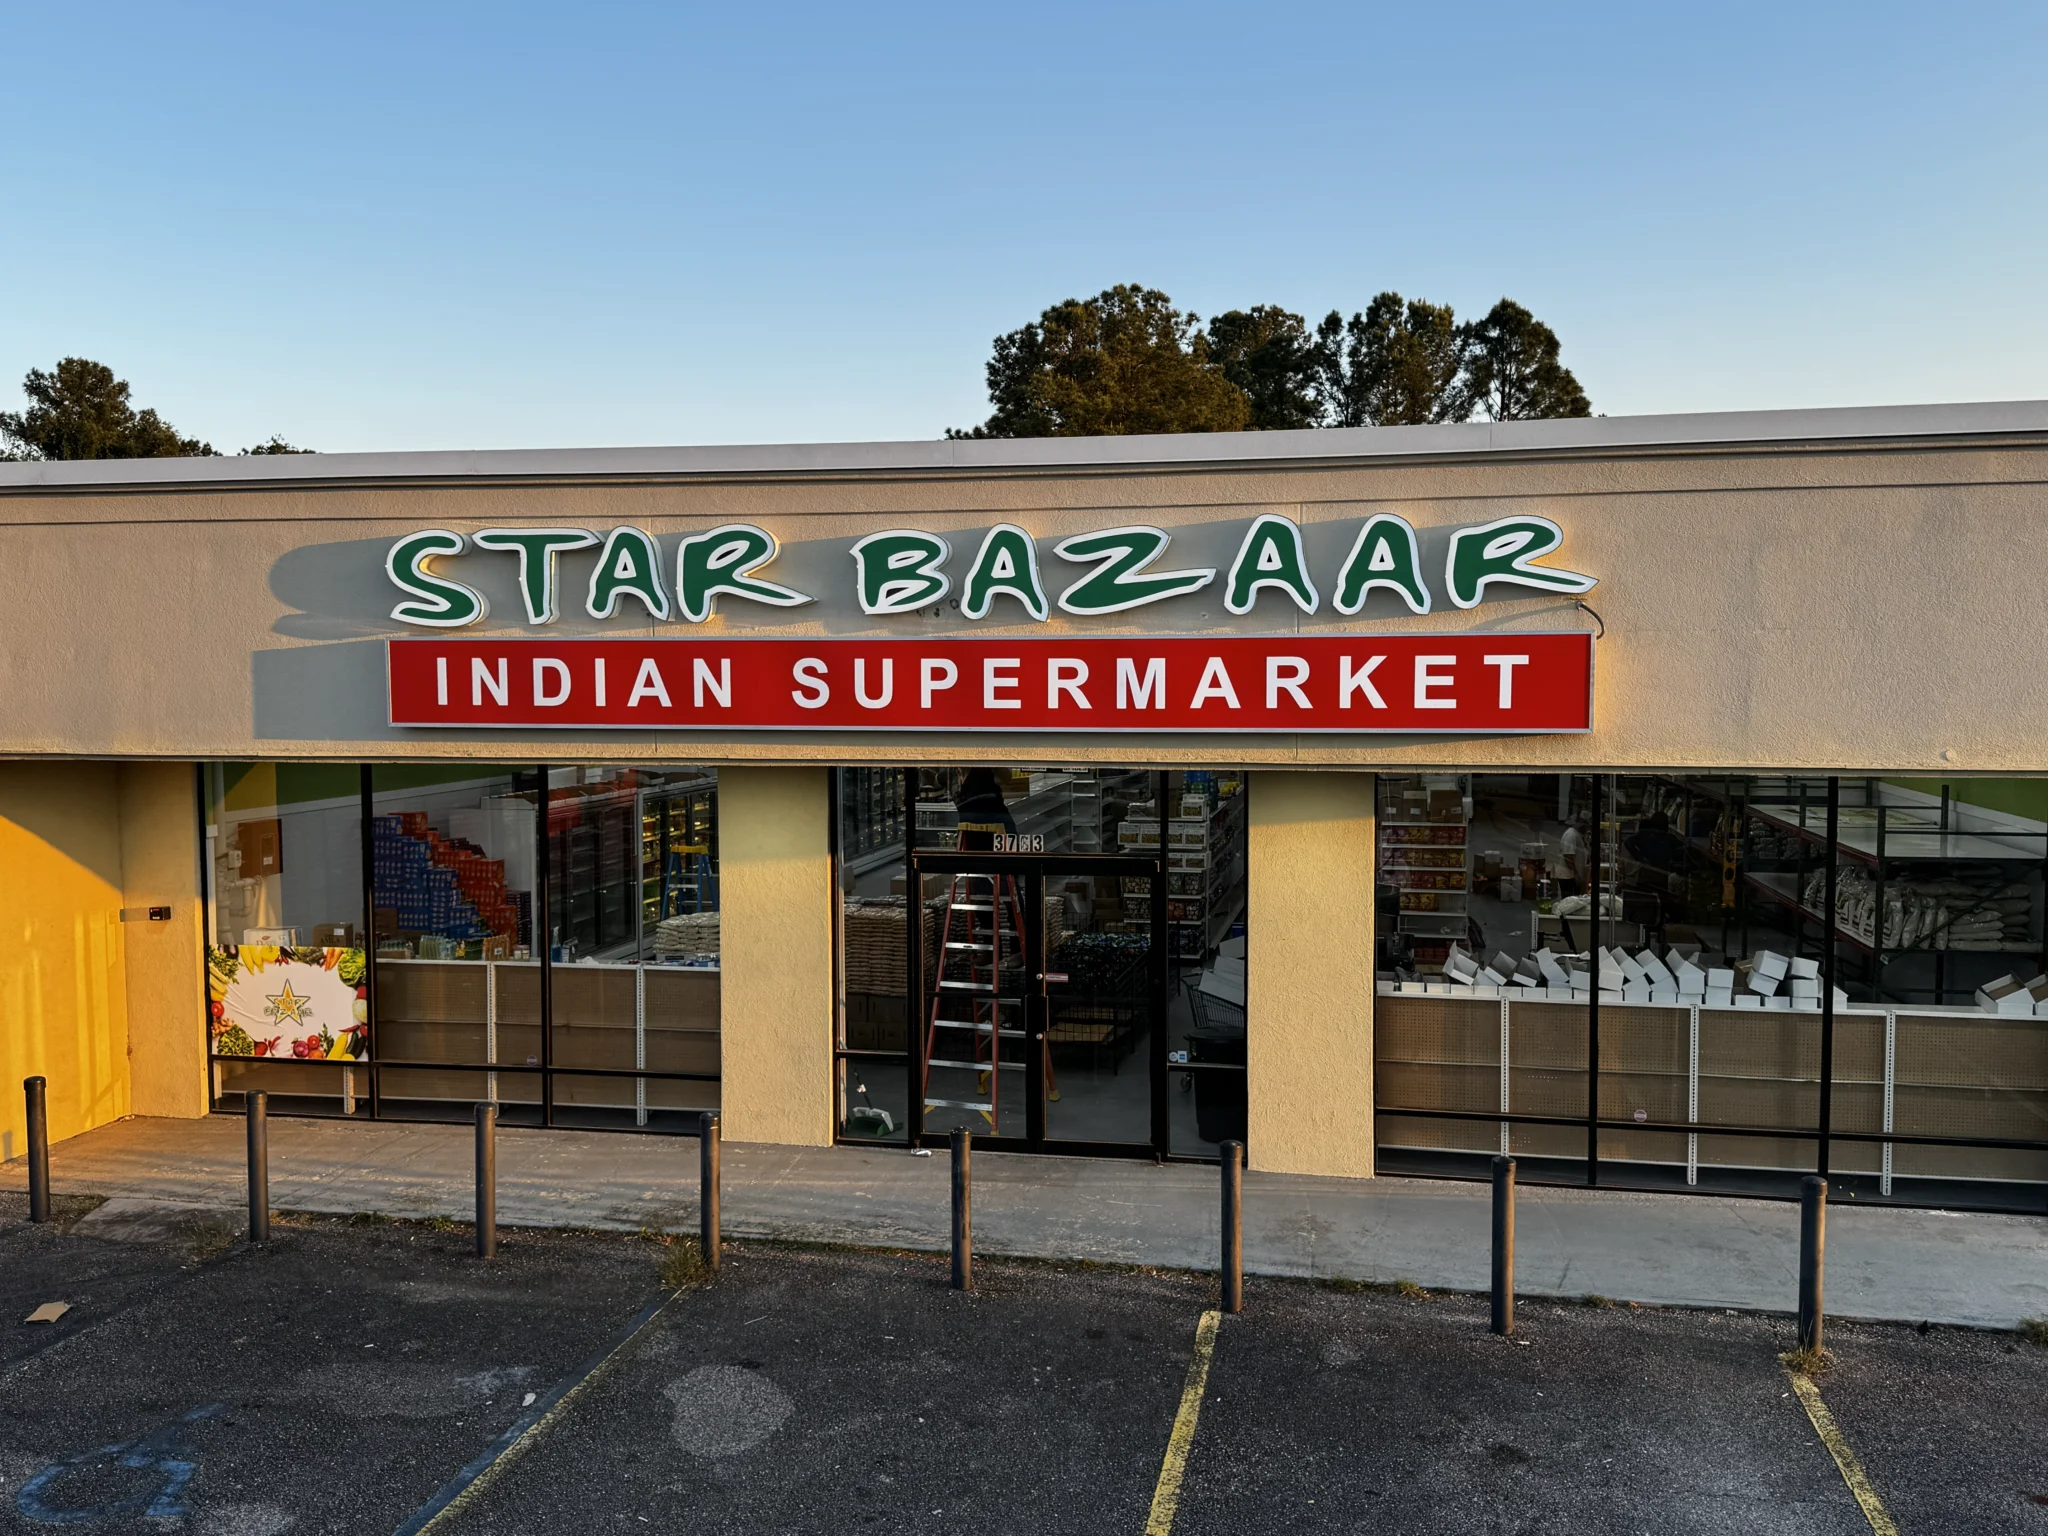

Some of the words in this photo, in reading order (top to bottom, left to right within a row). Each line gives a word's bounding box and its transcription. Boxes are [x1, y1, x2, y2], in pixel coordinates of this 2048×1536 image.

[385, 523, 818, 627] STAR
[849, 513, 1599, 622] BAZAAR
[435, 656, 732, 708] INDIAN
[791, 654, 1530, 710] SUPERMARKET
